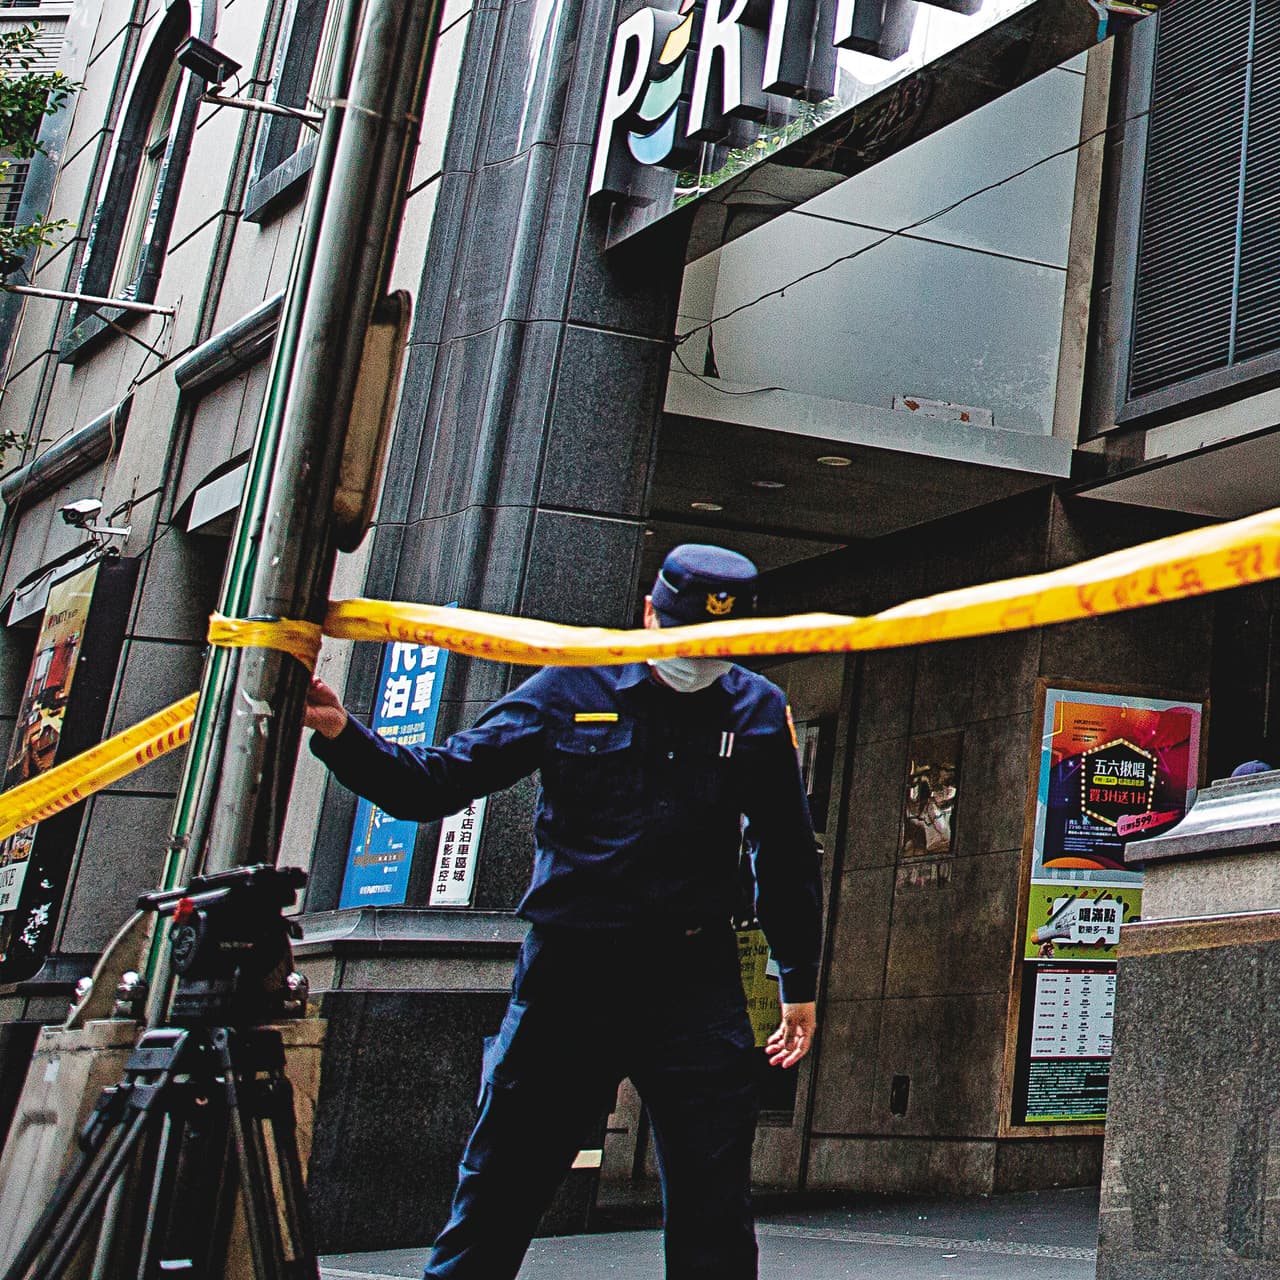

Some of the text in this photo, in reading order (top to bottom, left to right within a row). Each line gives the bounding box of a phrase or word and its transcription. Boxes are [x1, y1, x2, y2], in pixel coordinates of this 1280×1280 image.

[381, 672, 436, 718] 泊車
[1094, 759, 1146, 778] 五六揪唱
[1078, 908, 1116, 923] 唱滿點
